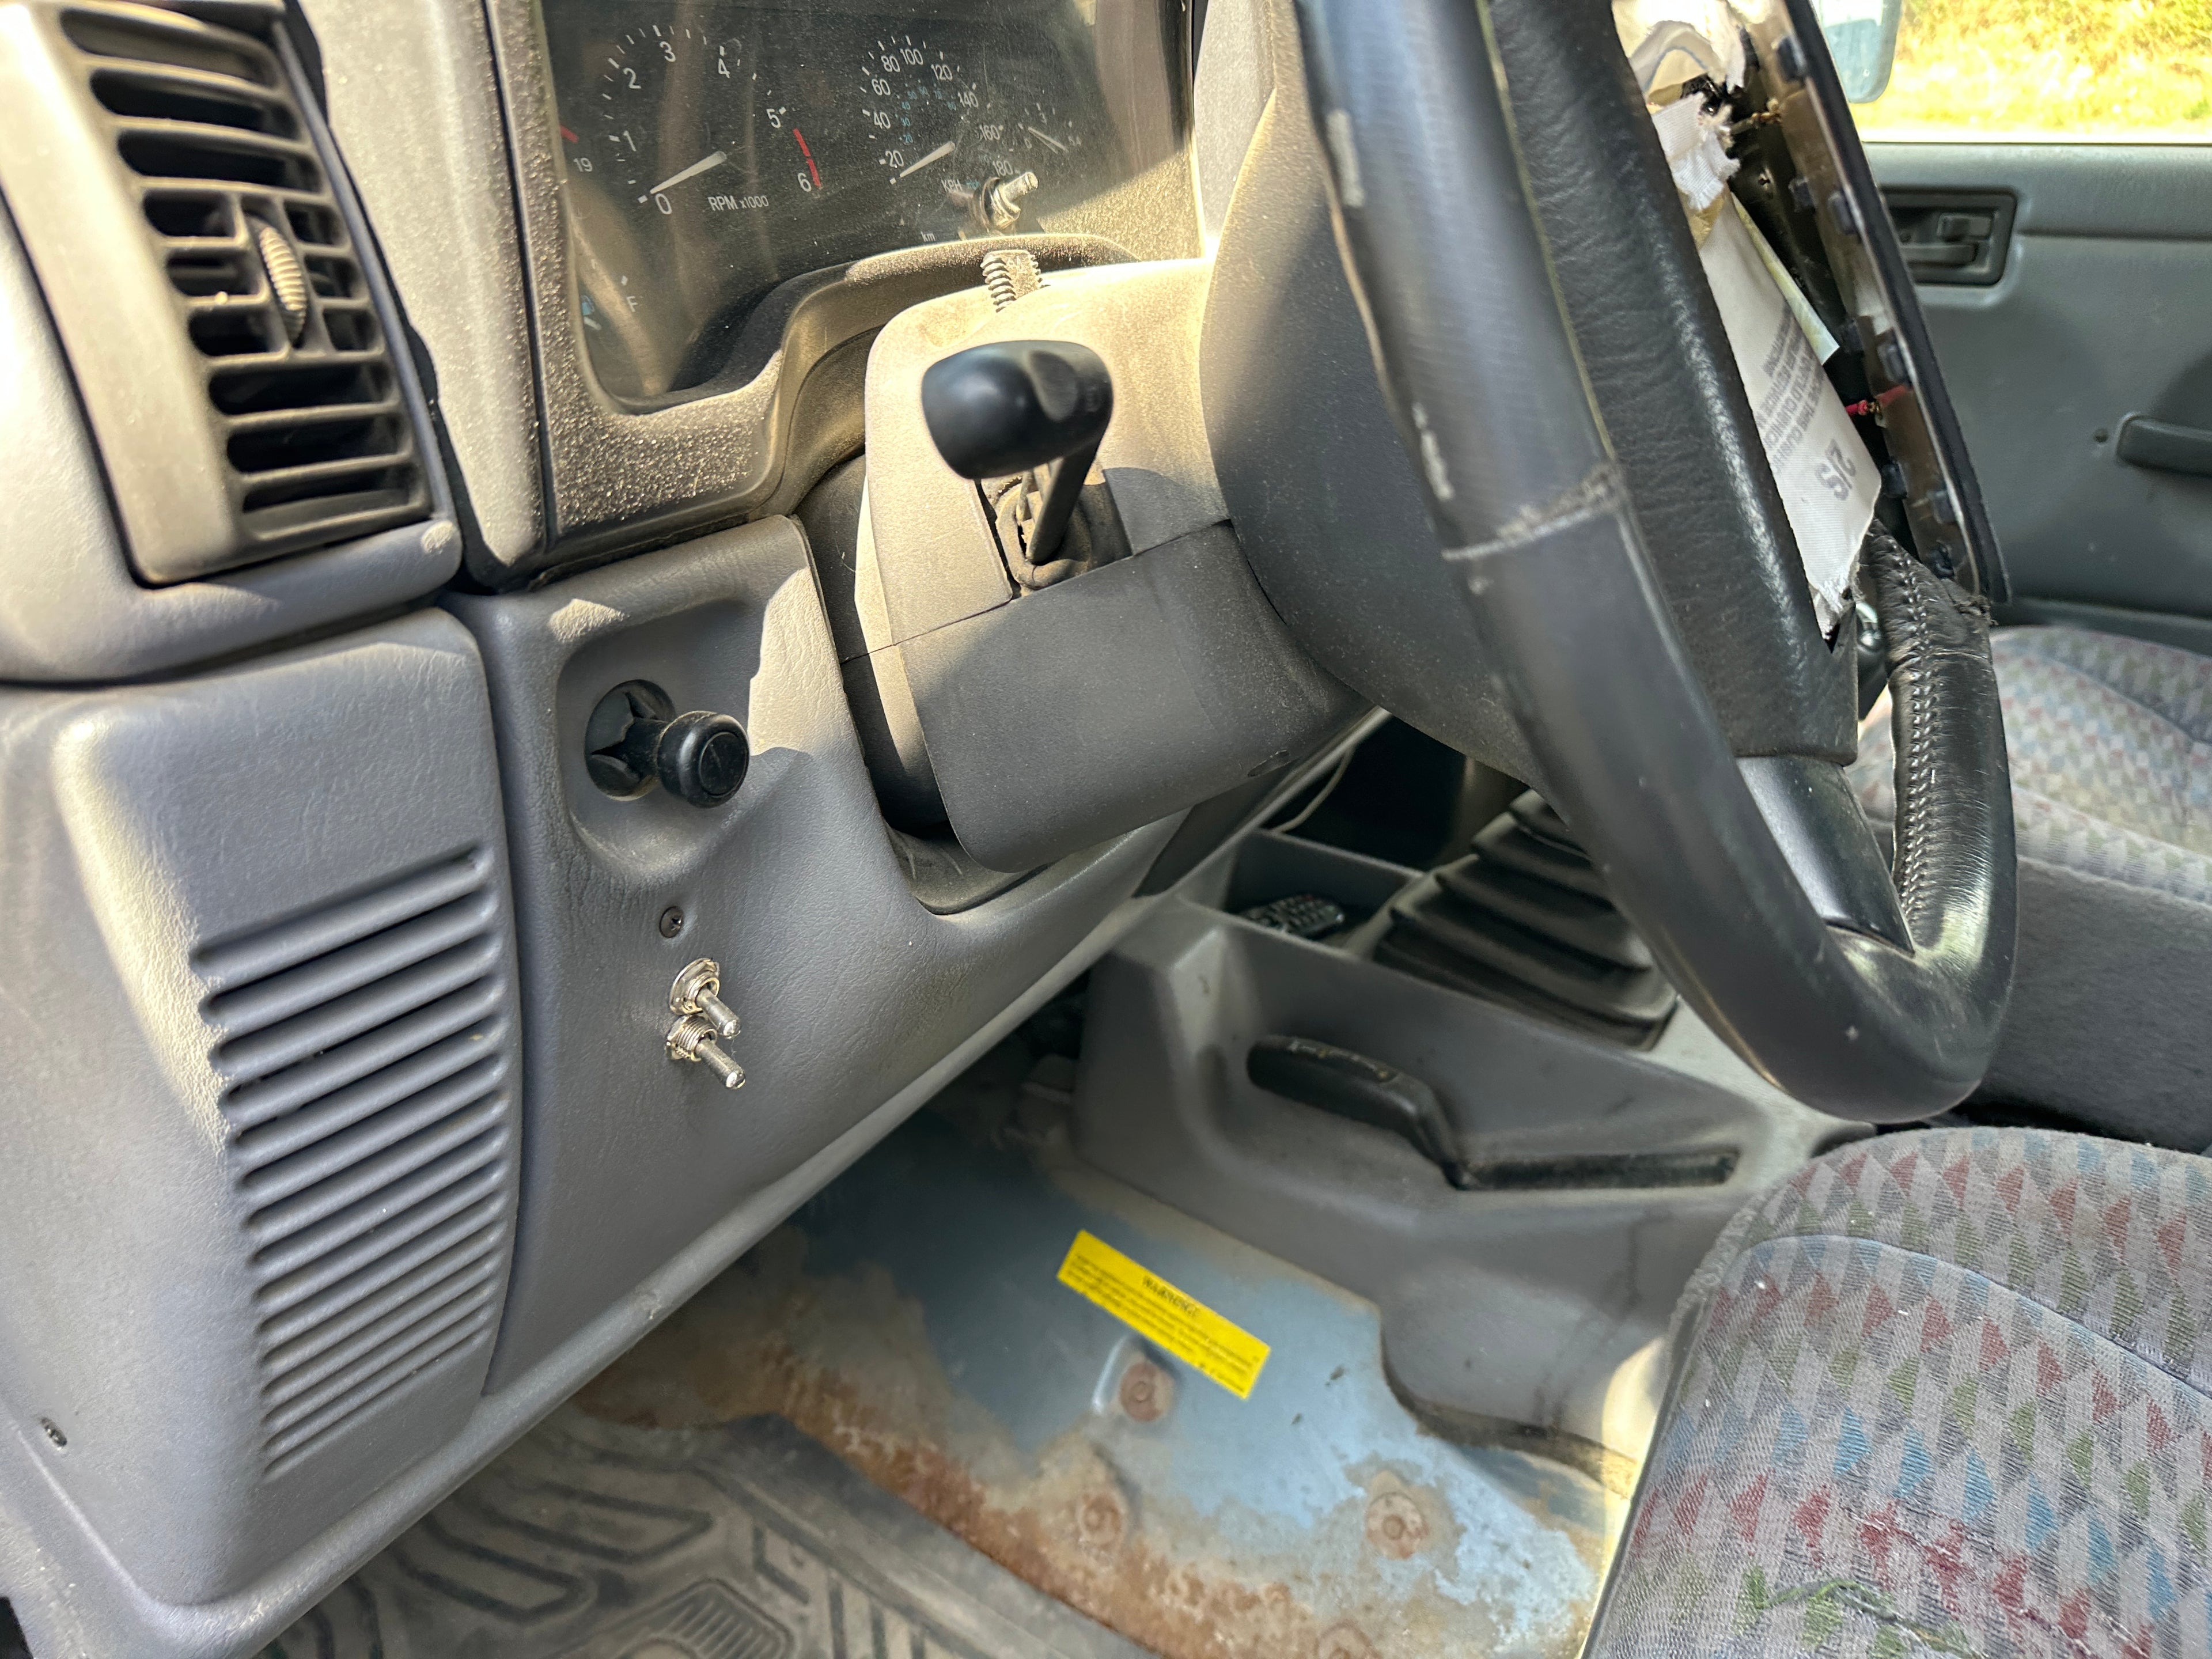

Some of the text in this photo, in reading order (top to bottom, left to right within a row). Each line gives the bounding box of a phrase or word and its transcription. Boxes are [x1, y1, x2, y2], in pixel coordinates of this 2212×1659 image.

[659, 41, 676, 63] 3
[900, 48, 923, 65] 100
[718, 58, 730, 79] 4
[881, 55, 901, 73] 80
[623, 67, 642, 89] 2
[930, 65, 953, 81] 120
[872, 78, 891, 96] 60
[957, 91, 979, 108] 140
[766, 108, 782, 128] 5
[873, 112, 891, 130] 40
[623, 130, 637, 152] 1
[903, 132, 914, 143] 20
[979, 124, 1001, 141] 160
[573, 157, 593, 172] 19
[885, 150, 904, 168] 20
[992, 160, 1013, 177] 180
[797, 173, 812, 192] 6
[941, 177, 963, 193] KPH
[655, 192, 673, 215] 0
[707, 195, 770, 212] RPM x1000
[921, 231, 936, 243] km
[626, 296, 639, 312] F
